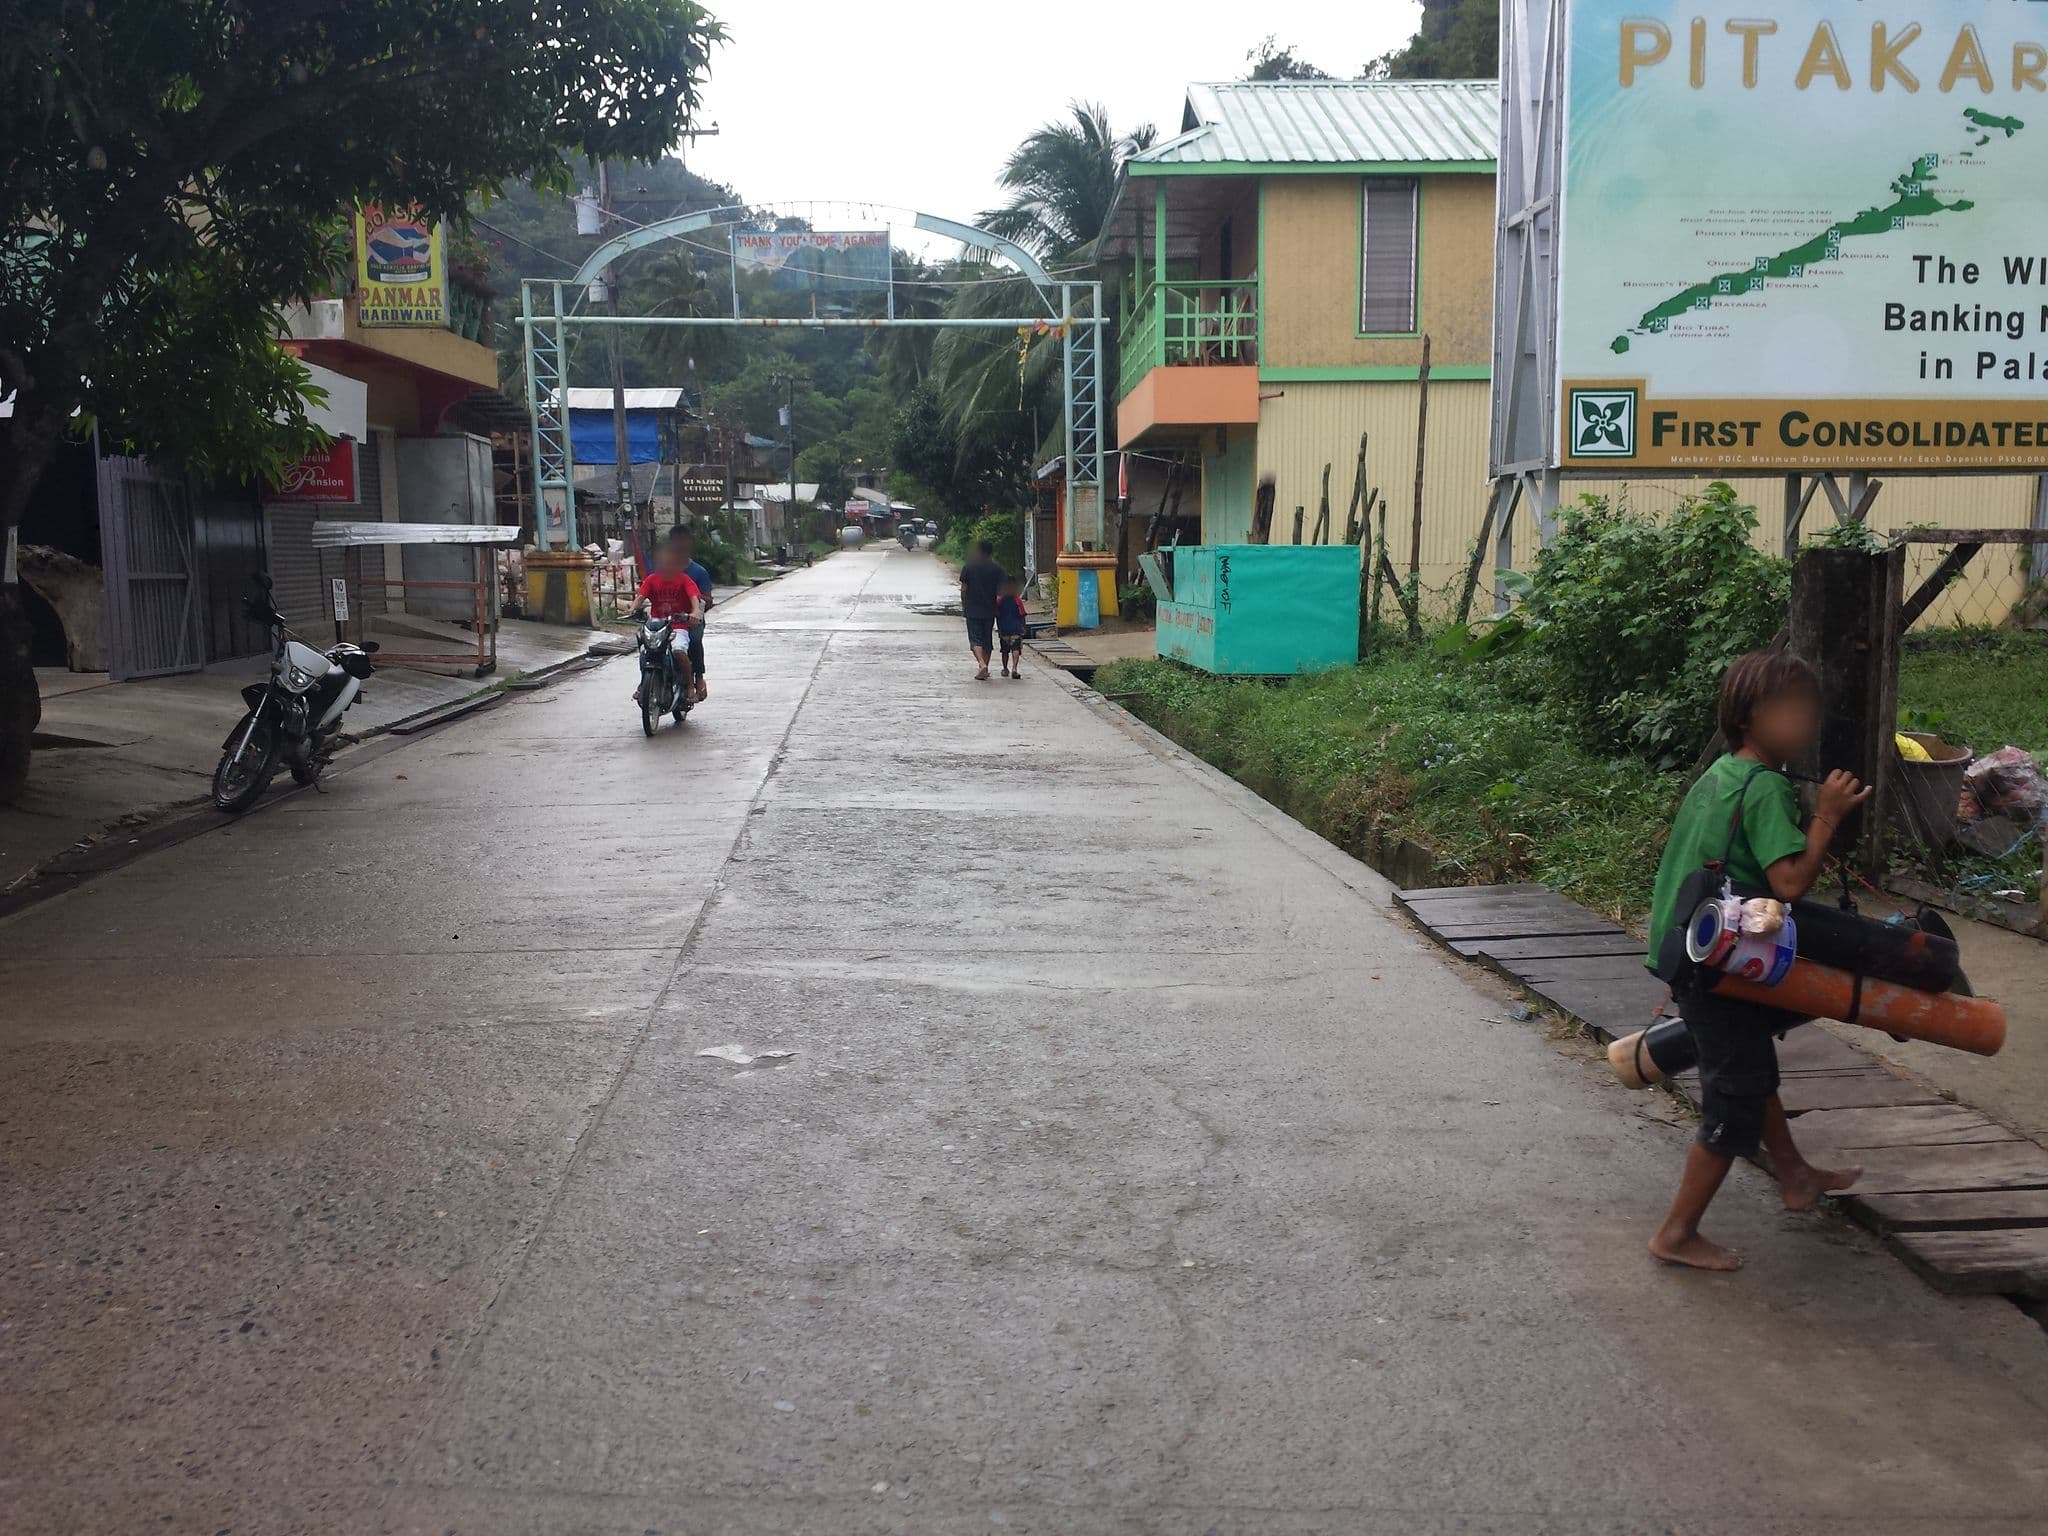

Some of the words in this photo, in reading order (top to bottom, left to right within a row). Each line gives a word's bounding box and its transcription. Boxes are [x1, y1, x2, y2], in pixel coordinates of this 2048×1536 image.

[736, 235, 772, 248] THANK
[1912, 254, 1980, 285] The
[2003, 256, 2048, 286] WI
[358, 287, 442, 307] PANMAR
[360, 308, 442, 321] HARDWARE
[1884, 302, 2025, 340] Banking
[1919, 351, 1953, 379] in
[1652, 411, 1762, 447] FIRST
[1751, 455, 1797, 463] Maximum
[1802, 455, 1840, 464] Deposit
[1845, 455, 1893, 463] Insurance
[1898, 455, 1913, 463] for
[1918, 455, 1941, 463] Each
[1945, 454, 1993, 464] Depositor
